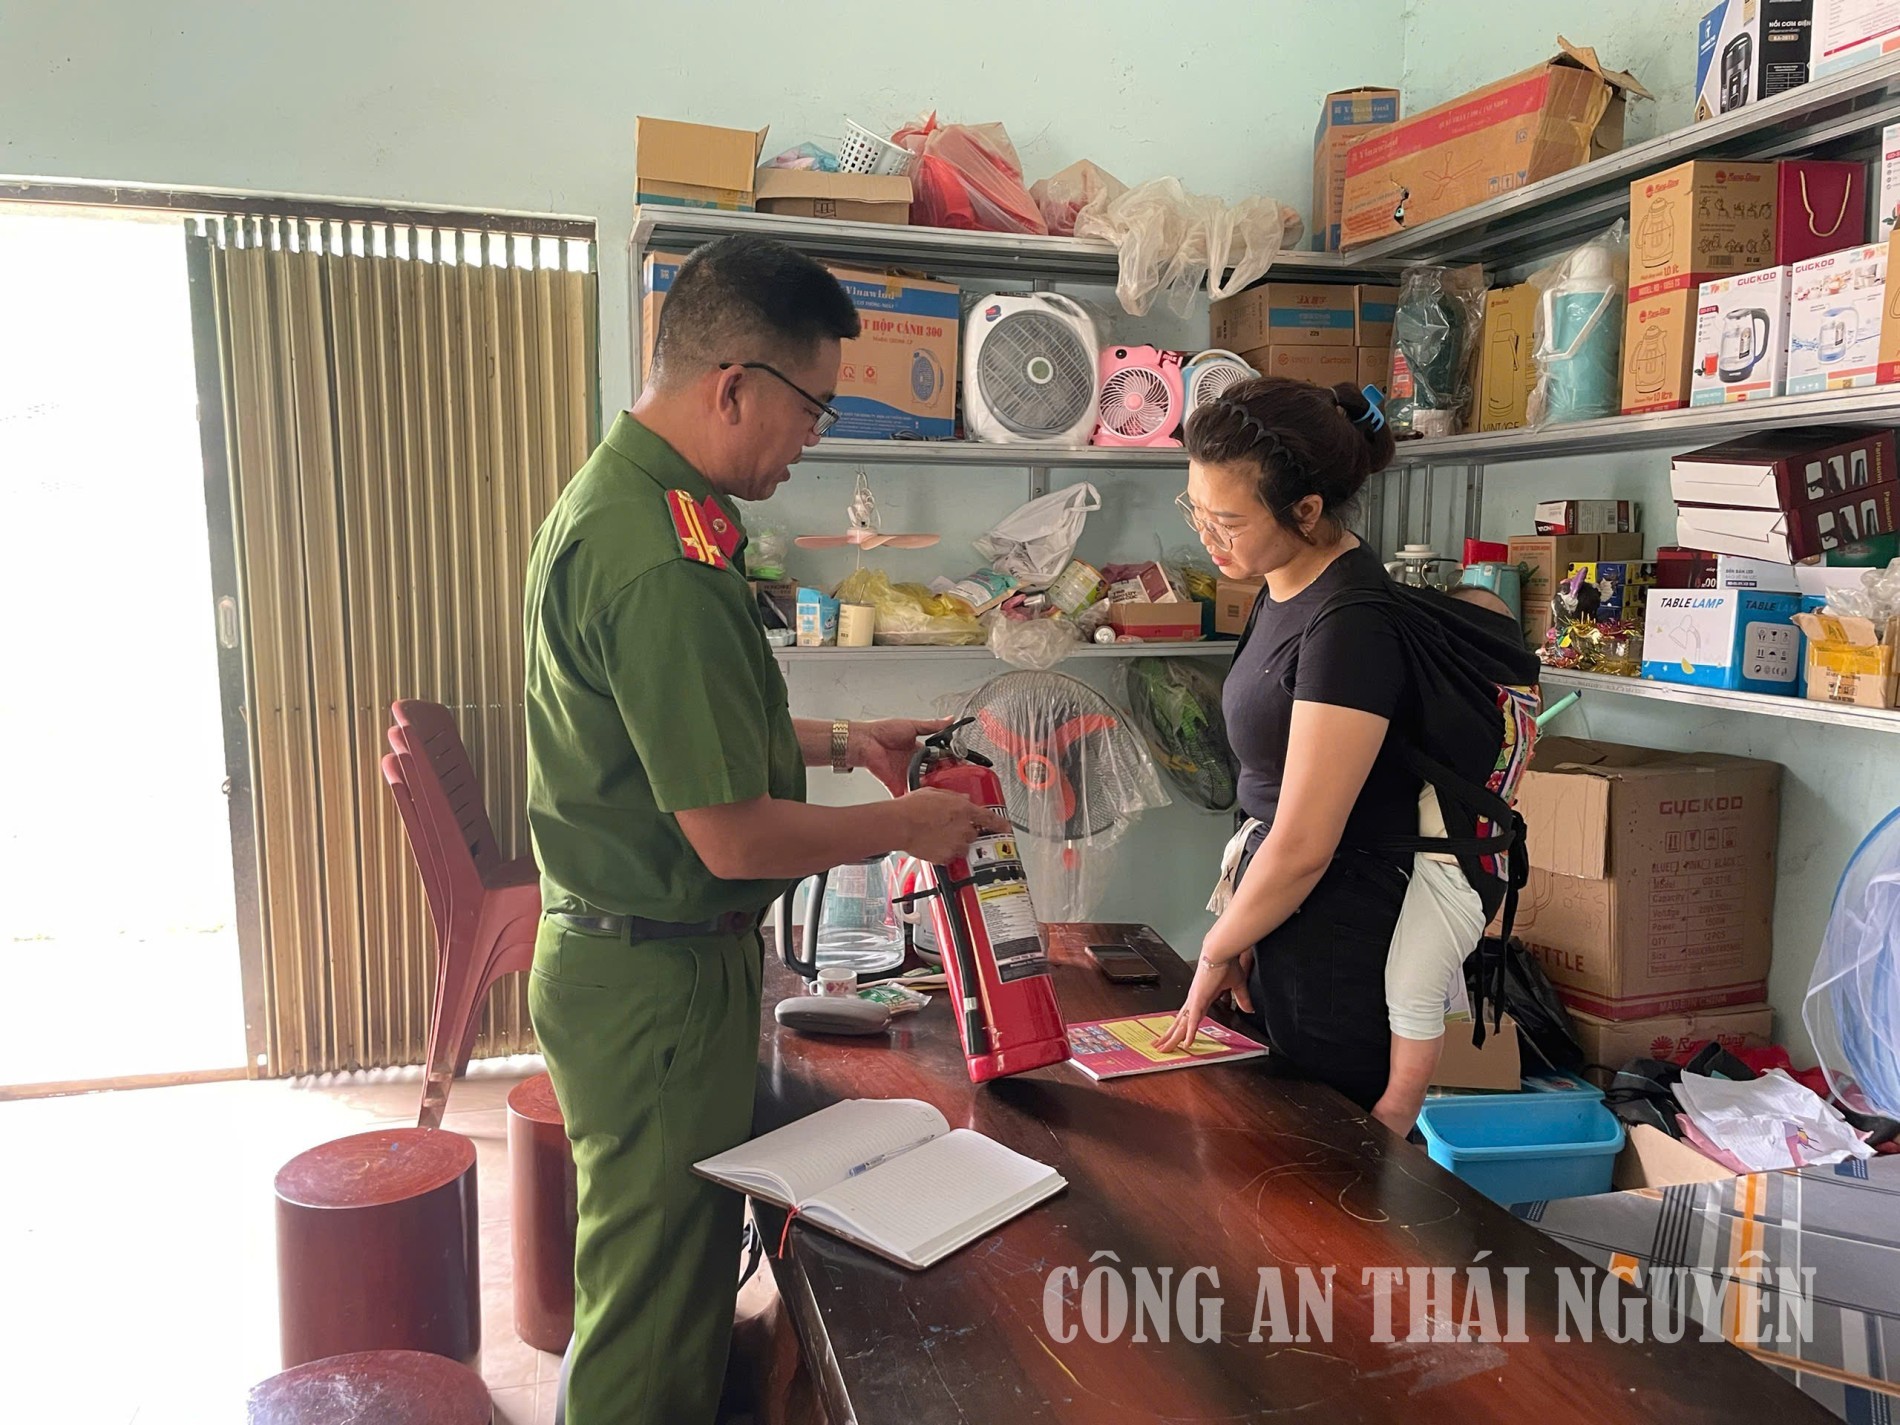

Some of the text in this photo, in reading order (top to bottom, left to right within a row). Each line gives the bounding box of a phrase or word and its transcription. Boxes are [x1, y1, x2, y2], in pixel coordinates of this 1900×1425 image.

[1795, 258, 1835, 274] CUCKOO
[1738, 272, 1776, 286] CUCKOO
[846, 286, 895, 300] Vinawind
[872, 318, 894, 335] HỘP
[896, 322, 924, 336] CÁNH
[925, 326, 943, 338] 300
[1660, 597, 1724, 609] TABLE LAMP
[1745, 600, 1776, 611] TABLE
[1659, 796, 1743, 815] CUCKOO
[1652, 894, 1685, 903] Capacity
[1652, 923, 1675, 931] Power
[1652, 936, 1668, 946] QTY
